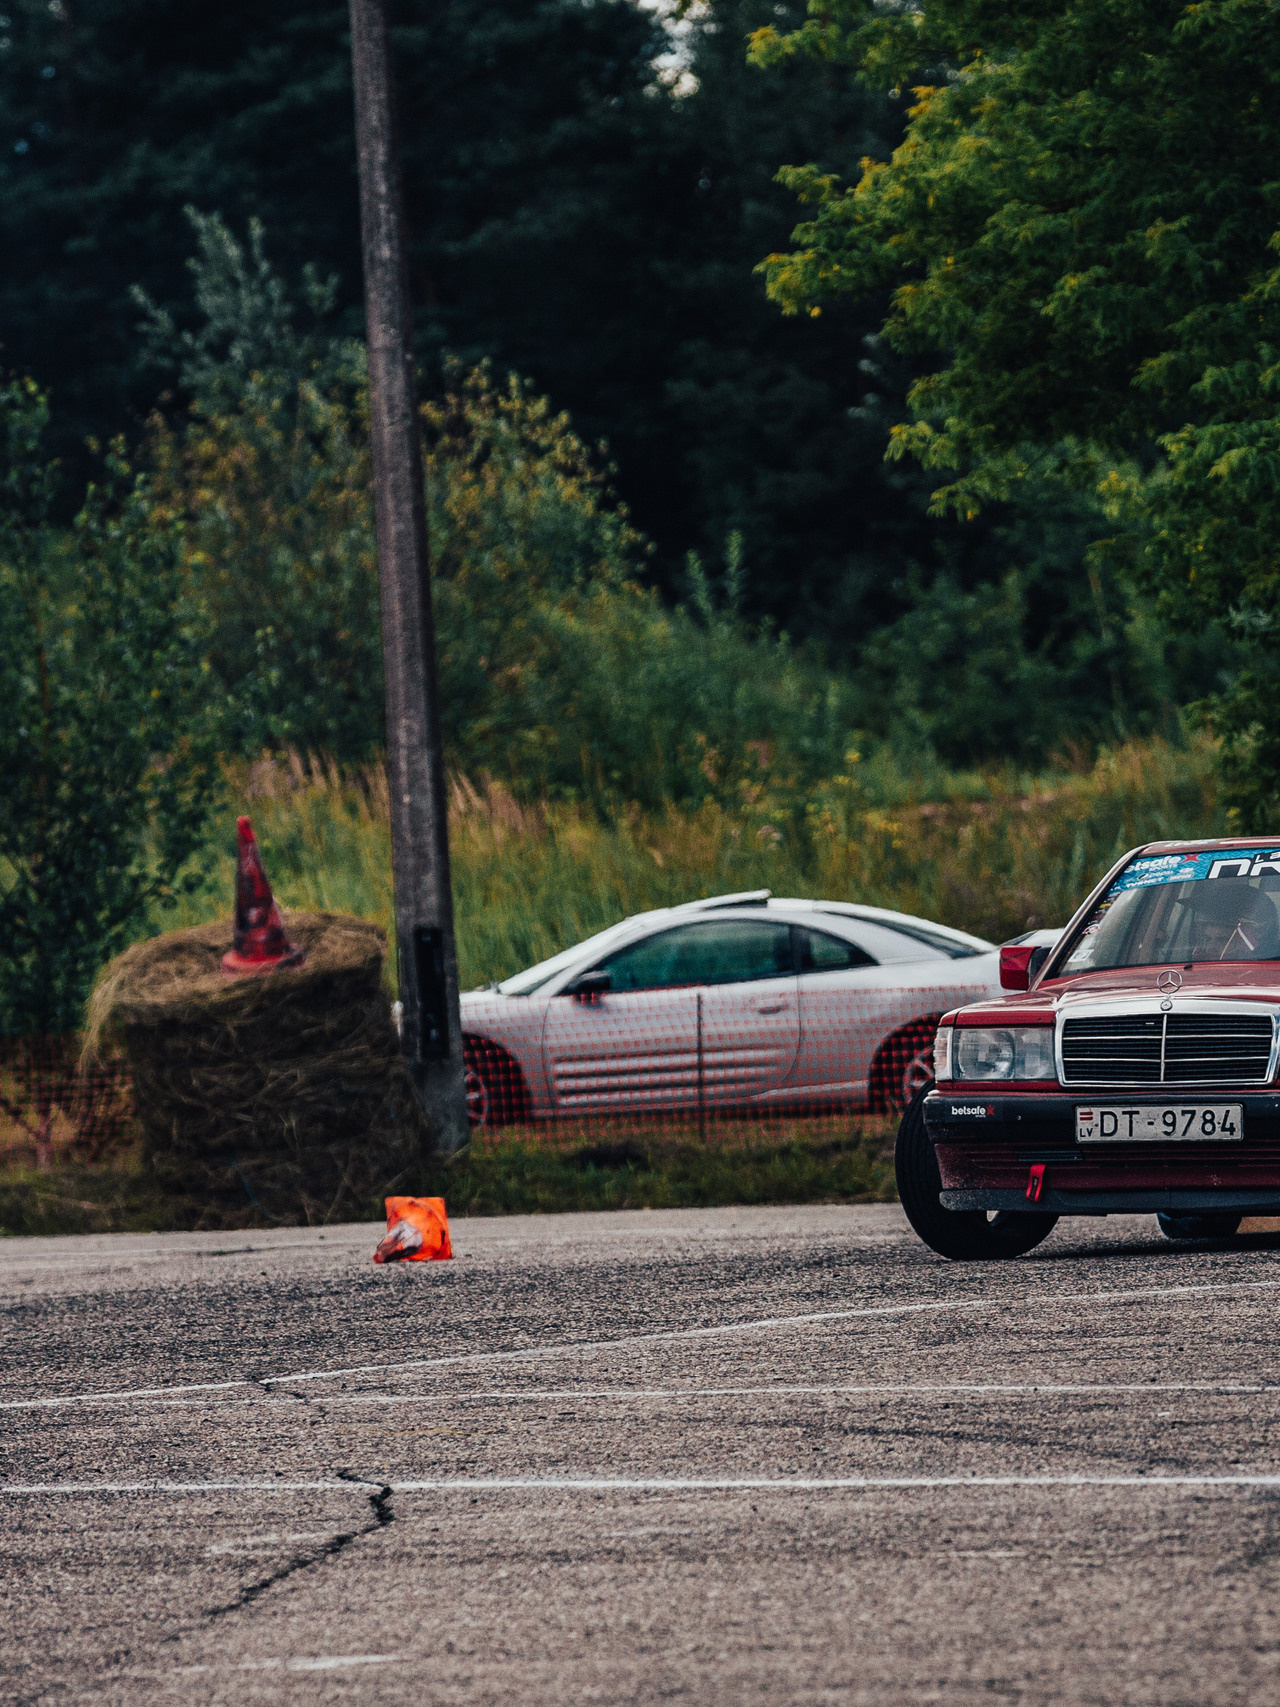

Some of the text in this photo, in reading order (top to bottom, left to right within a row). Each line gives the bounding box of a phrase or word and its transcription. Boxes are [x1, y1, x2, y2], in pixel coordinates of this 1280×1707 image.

[1124, 855, 1182, 873] etsafe
[951, 1105, 986, 1115] betsafe
[1079, 1127, 1093, 1138] LV
